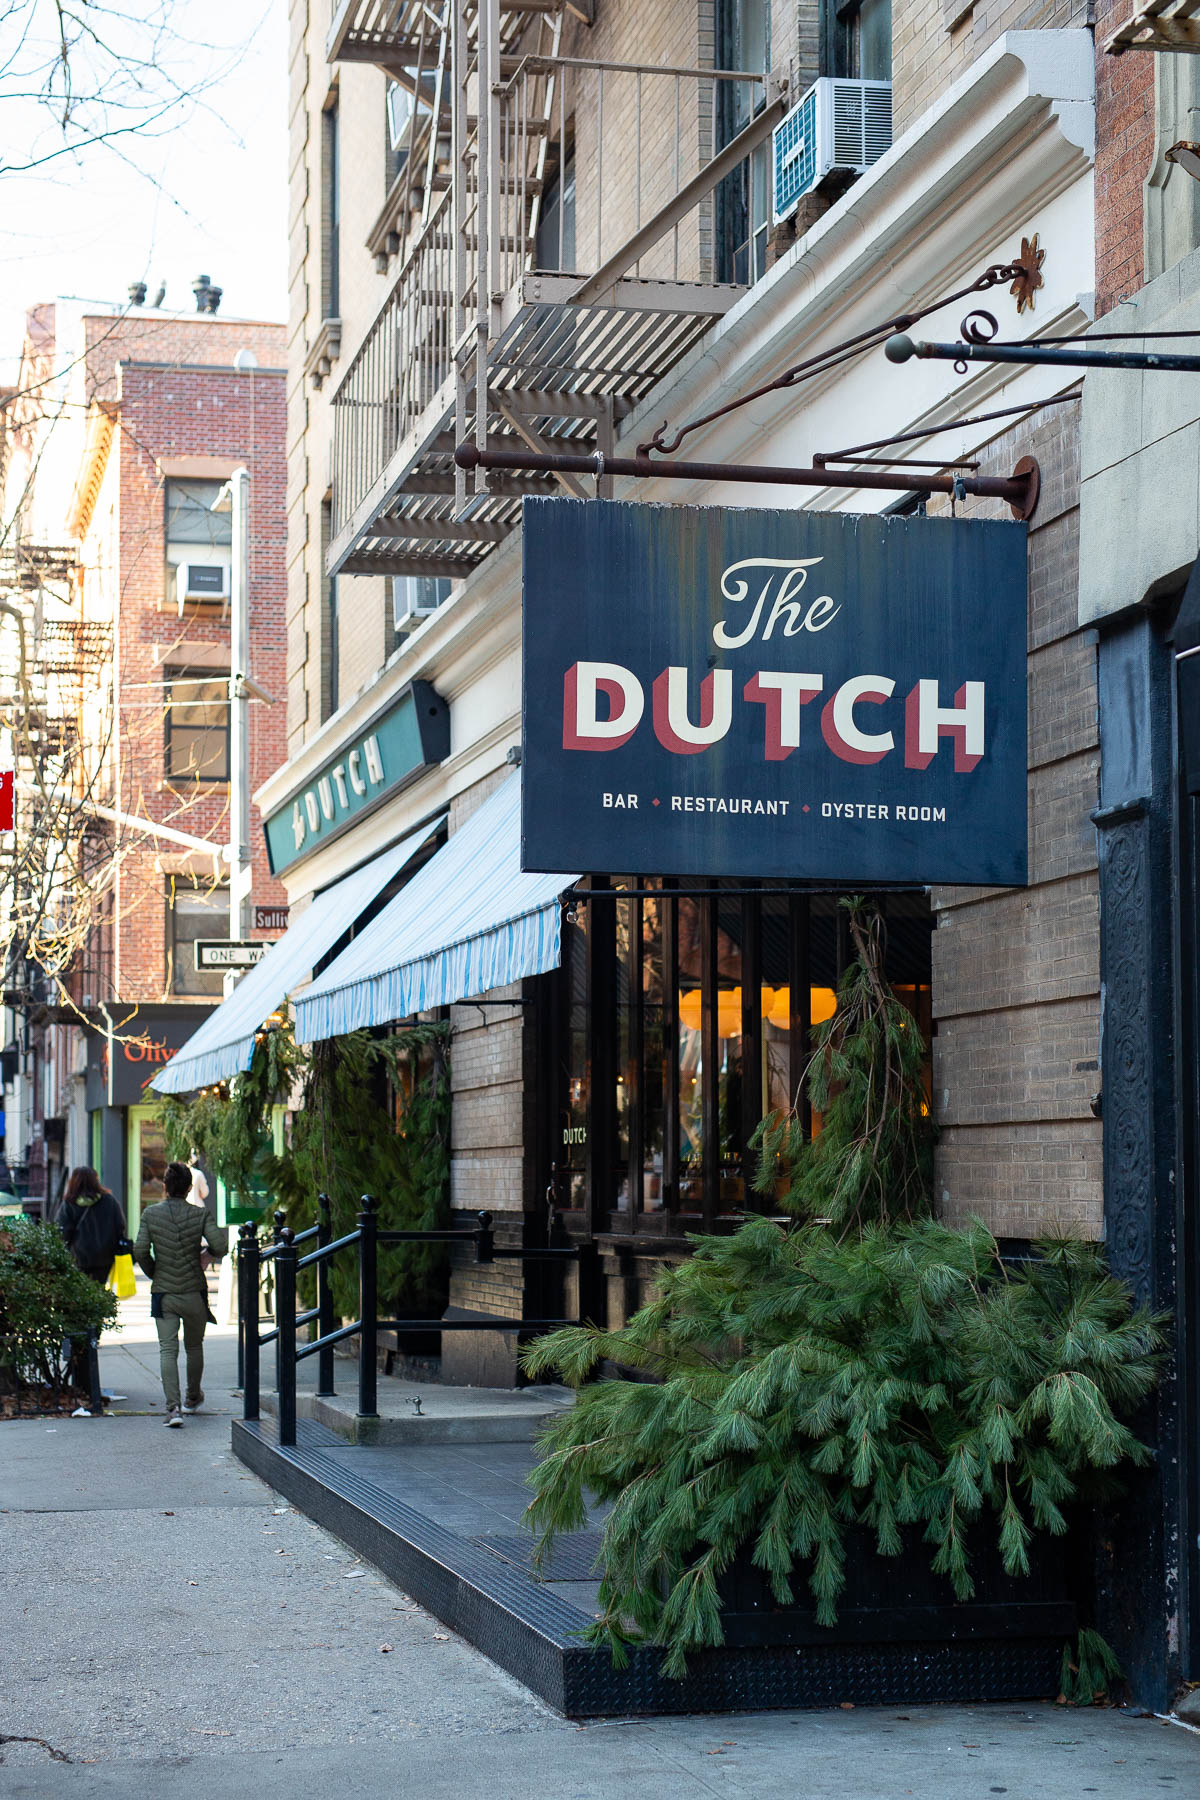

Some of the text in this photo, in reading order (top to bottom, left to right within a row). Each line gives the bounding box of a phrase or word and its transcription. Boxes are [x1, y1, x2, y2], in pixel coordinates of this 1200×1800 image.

[712, 556, 842, 649] The
[562, 661, 985, 773] DUTCH
[305, 734, 385, 833] DUTCH
[602, 792, 946, 822] BAR RESTAURANT OYSTER ROOM
[210, 950, 266, 961] ONE WA
